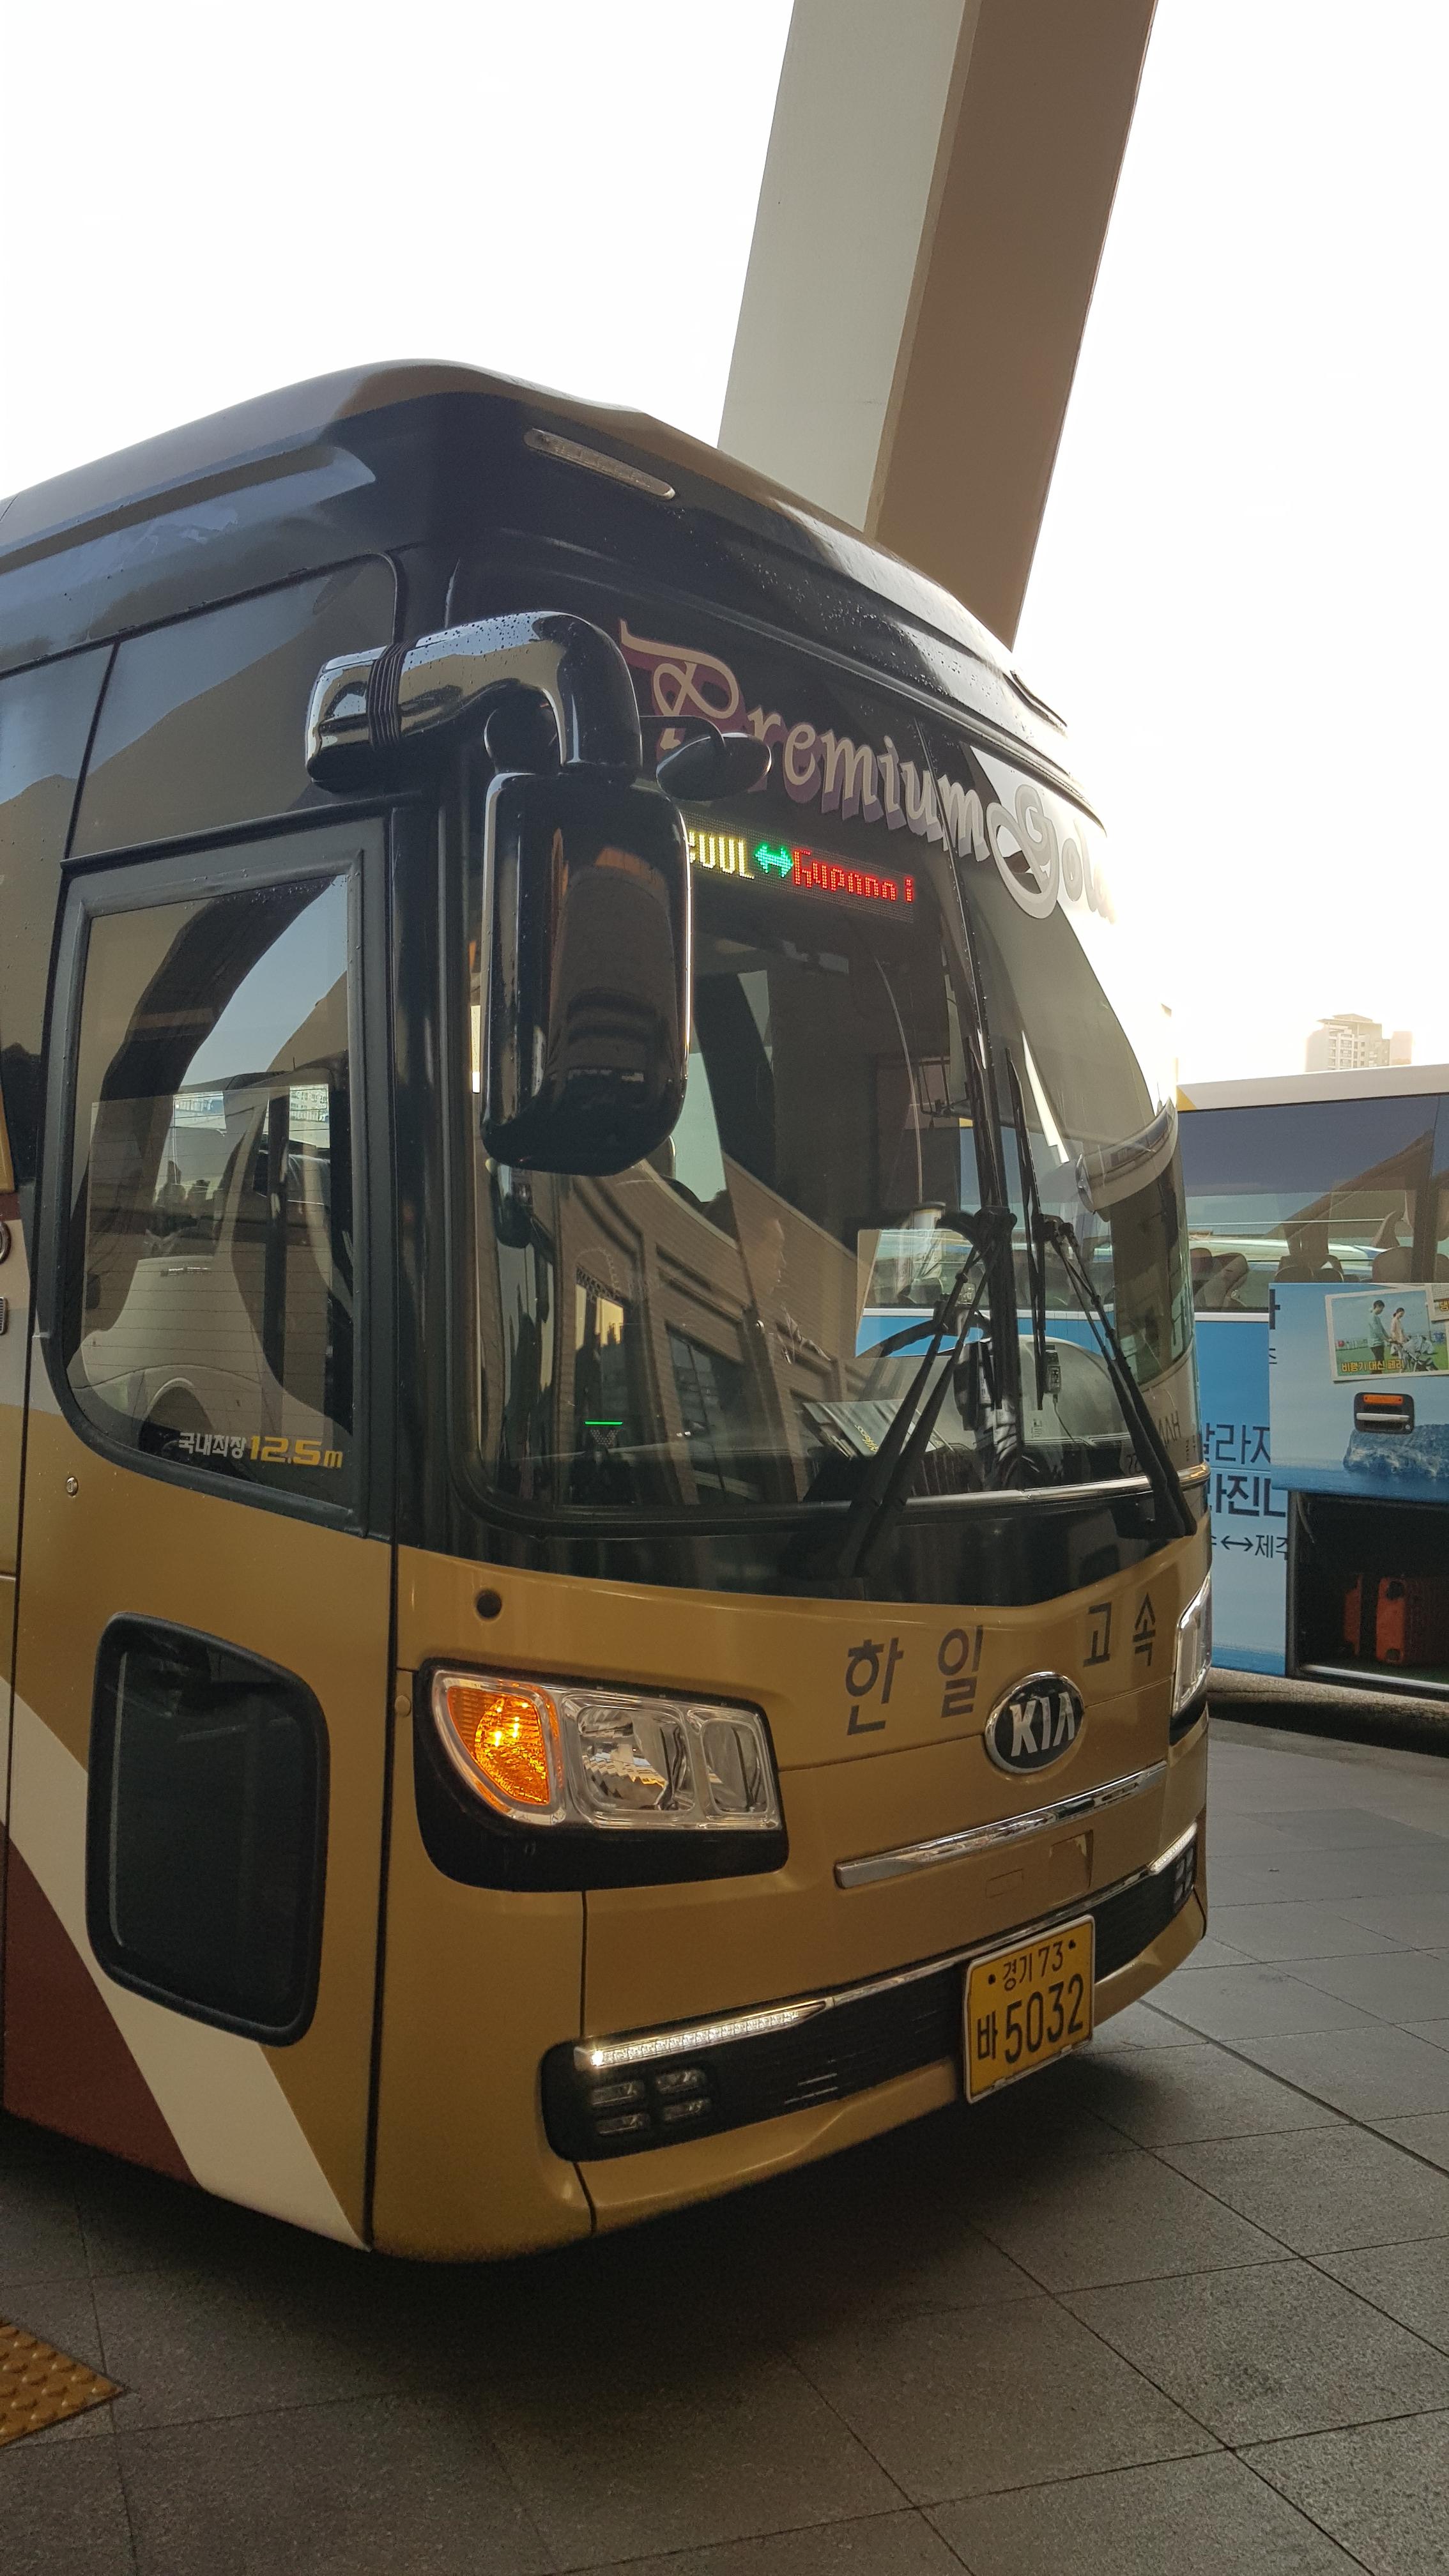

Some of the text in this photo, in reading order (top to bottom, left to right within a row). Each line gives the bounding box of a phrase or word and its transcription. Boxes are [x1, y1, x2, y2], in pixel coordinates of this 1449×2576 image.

[620, 619, 988, 861] Premium
[1342, 1361, 1367, 1372] 비행기
[1368, 1360, 1386, 1370] 대신
[179, 1432, 247, 1459] 국내최장
[1009, 1691, 1075, 1758] KIA
